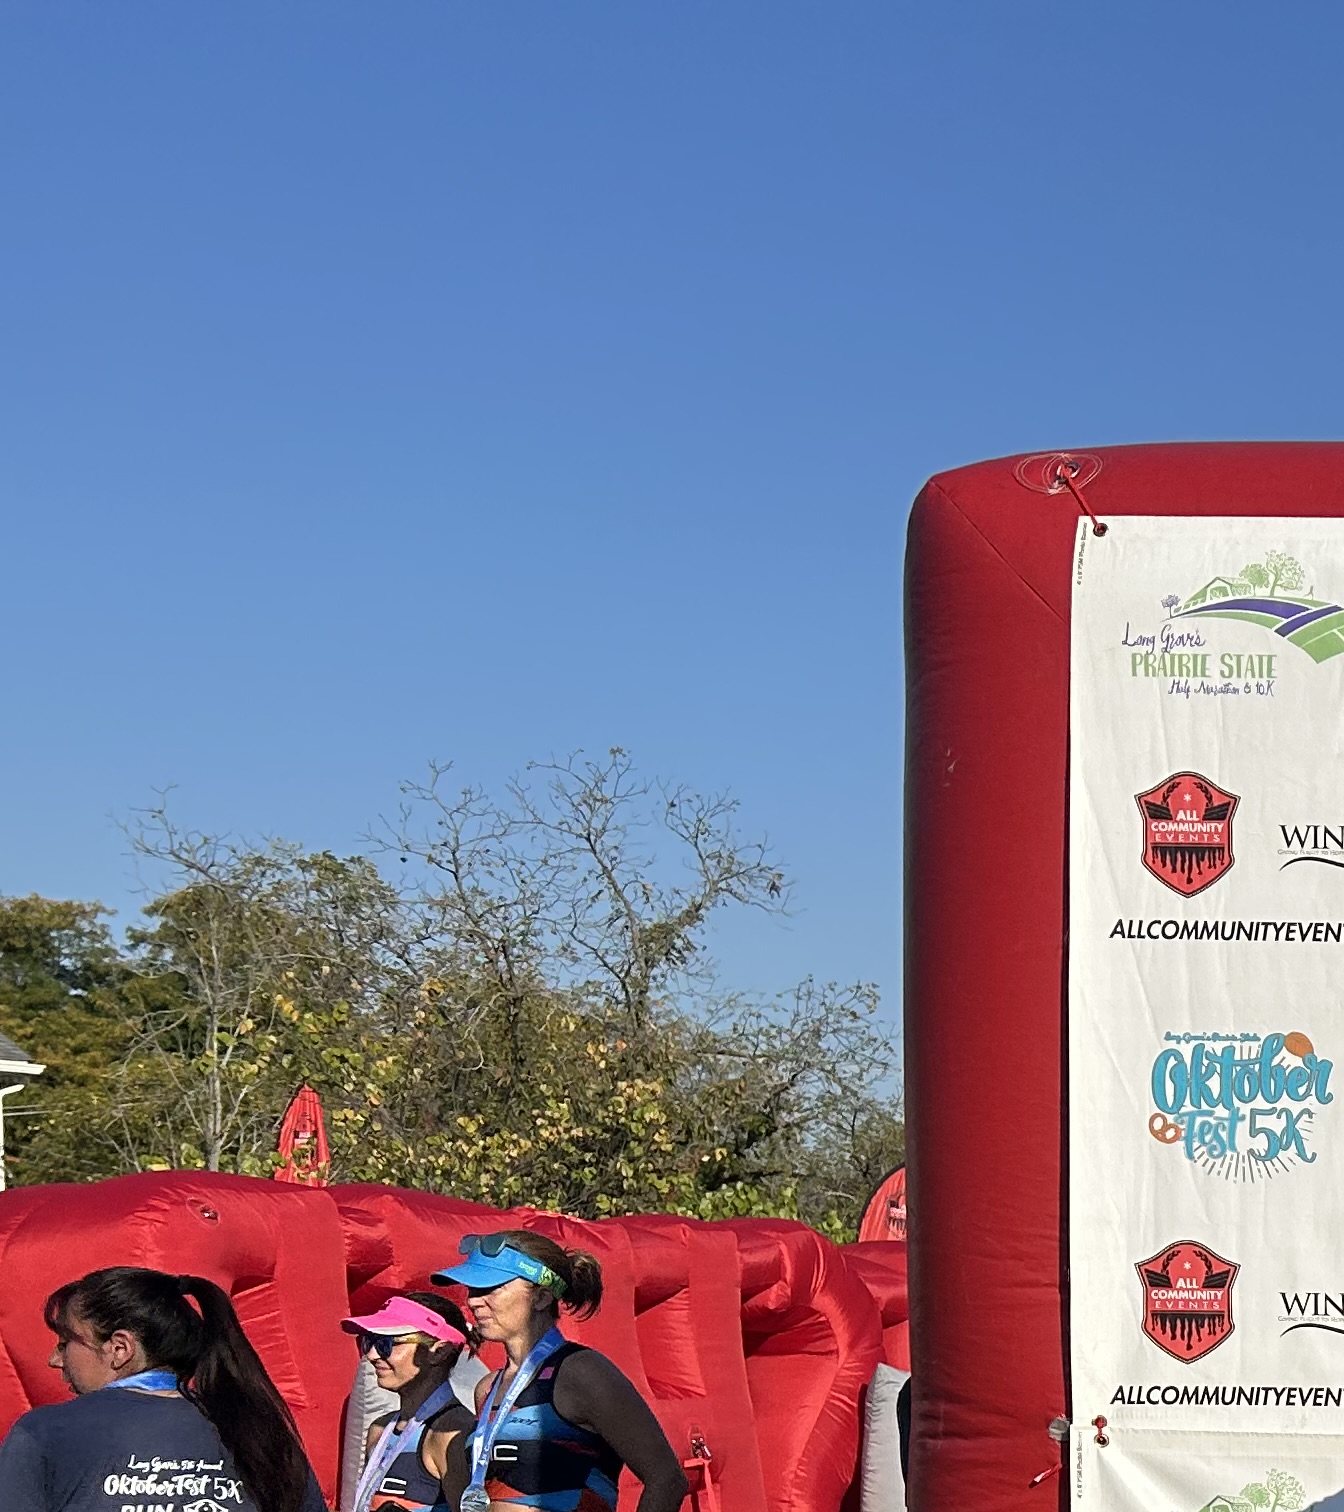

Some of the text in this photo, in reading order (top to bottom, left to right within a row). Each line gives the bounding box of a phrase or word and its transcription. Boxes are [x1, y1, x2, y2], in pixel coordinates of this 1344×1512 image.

[1131, 653, 1279, 679] PRAIRIE STATE
[1176, 809, 1199, 820] ALL
[1151, 821, 1224, 832] COMMUNITY
[1155, 832, 1220, 841] EVENTS
[1151, 1032, 1334, 1116] Oktober
[1173, 1106, 1317, 1163] Fest 5K
[1176, 1277, 1199, 1288] ALL
[1151, 1289, 1224, 1299] COMMUNITY
[1155, 1299, 1220, 1309] EVENTS
[214, 1478, 244, 1504] 5K
